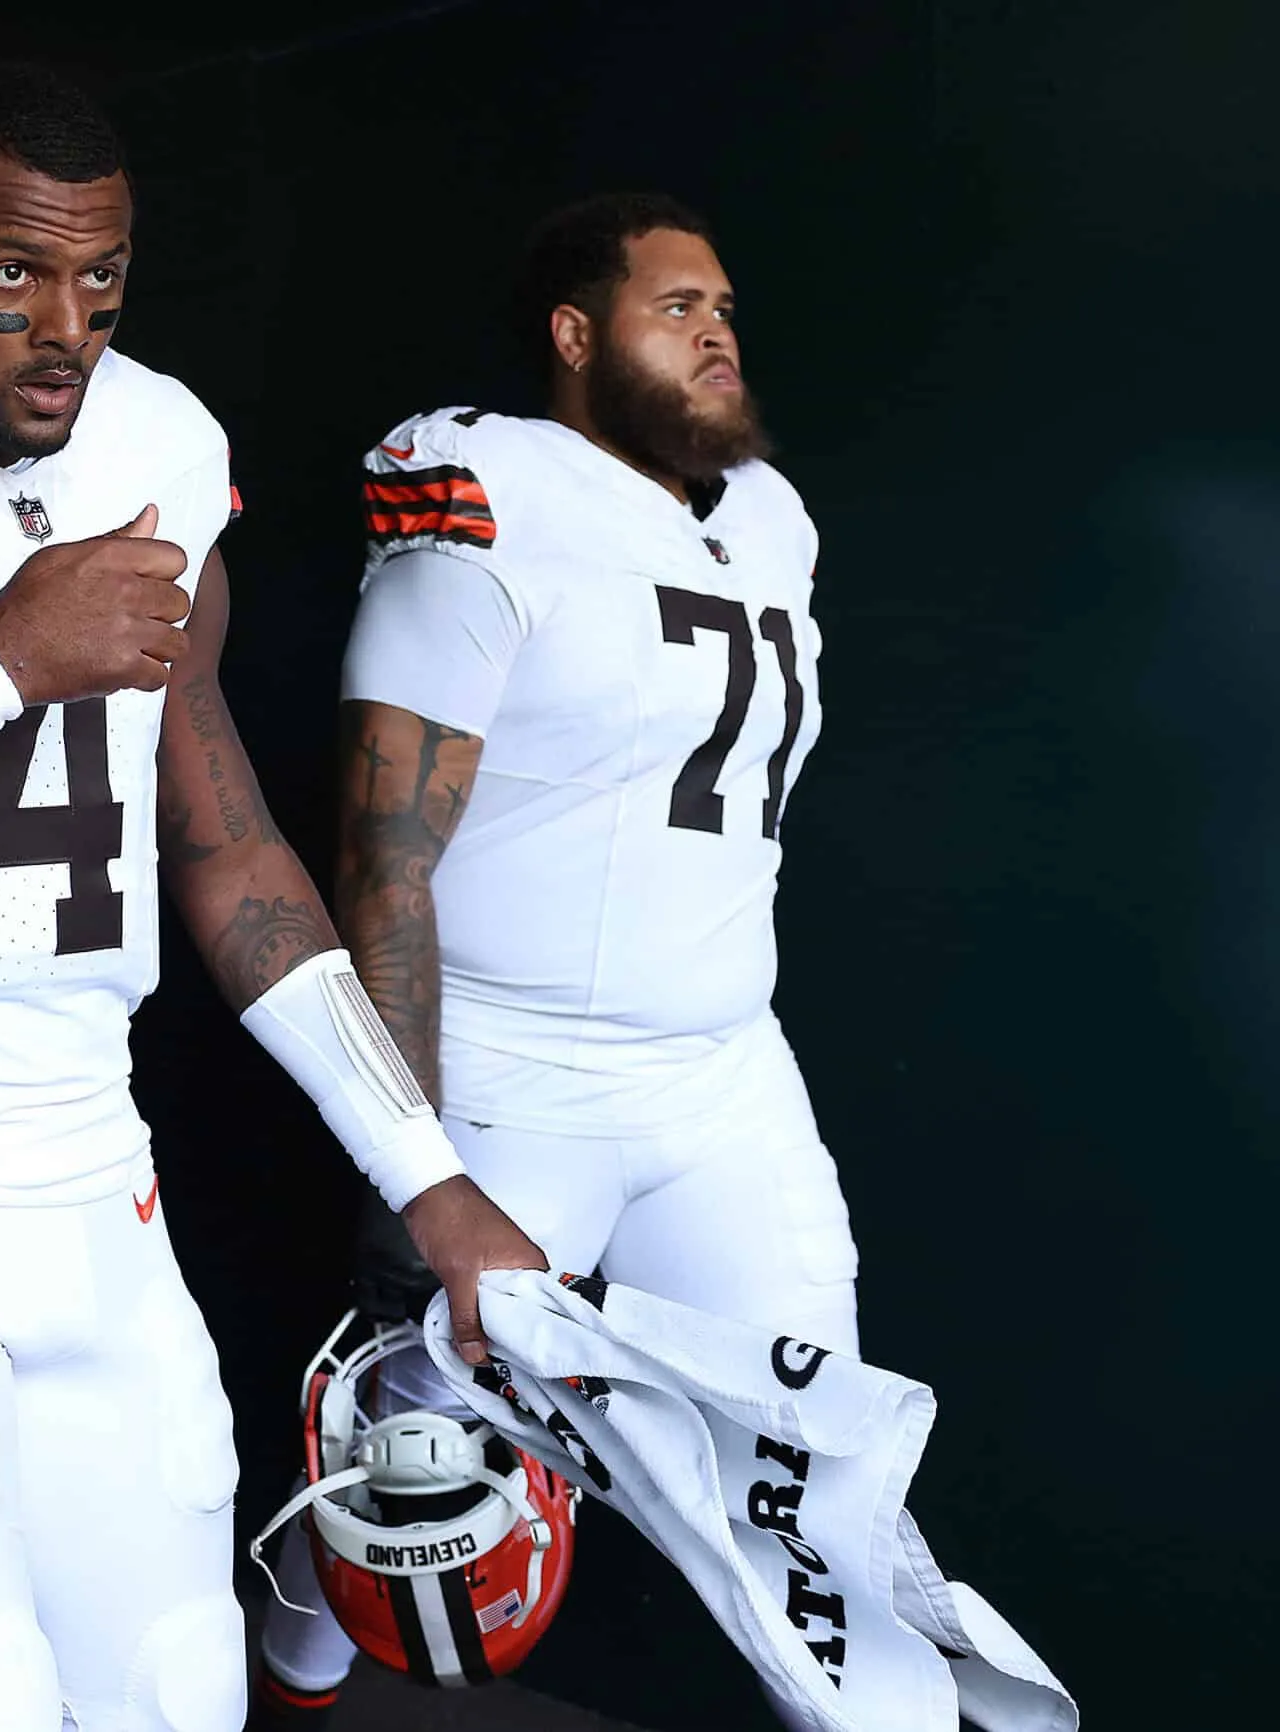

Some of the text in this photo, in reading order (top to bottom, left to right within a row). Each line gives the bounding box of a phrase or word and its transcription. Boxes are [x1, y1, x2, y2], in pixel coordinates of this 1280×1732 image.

[21, 513, 49, 535] NFL
[654, 584, 804, 840] 71
[366, 1532, 478, 1568] CLEVELAND
